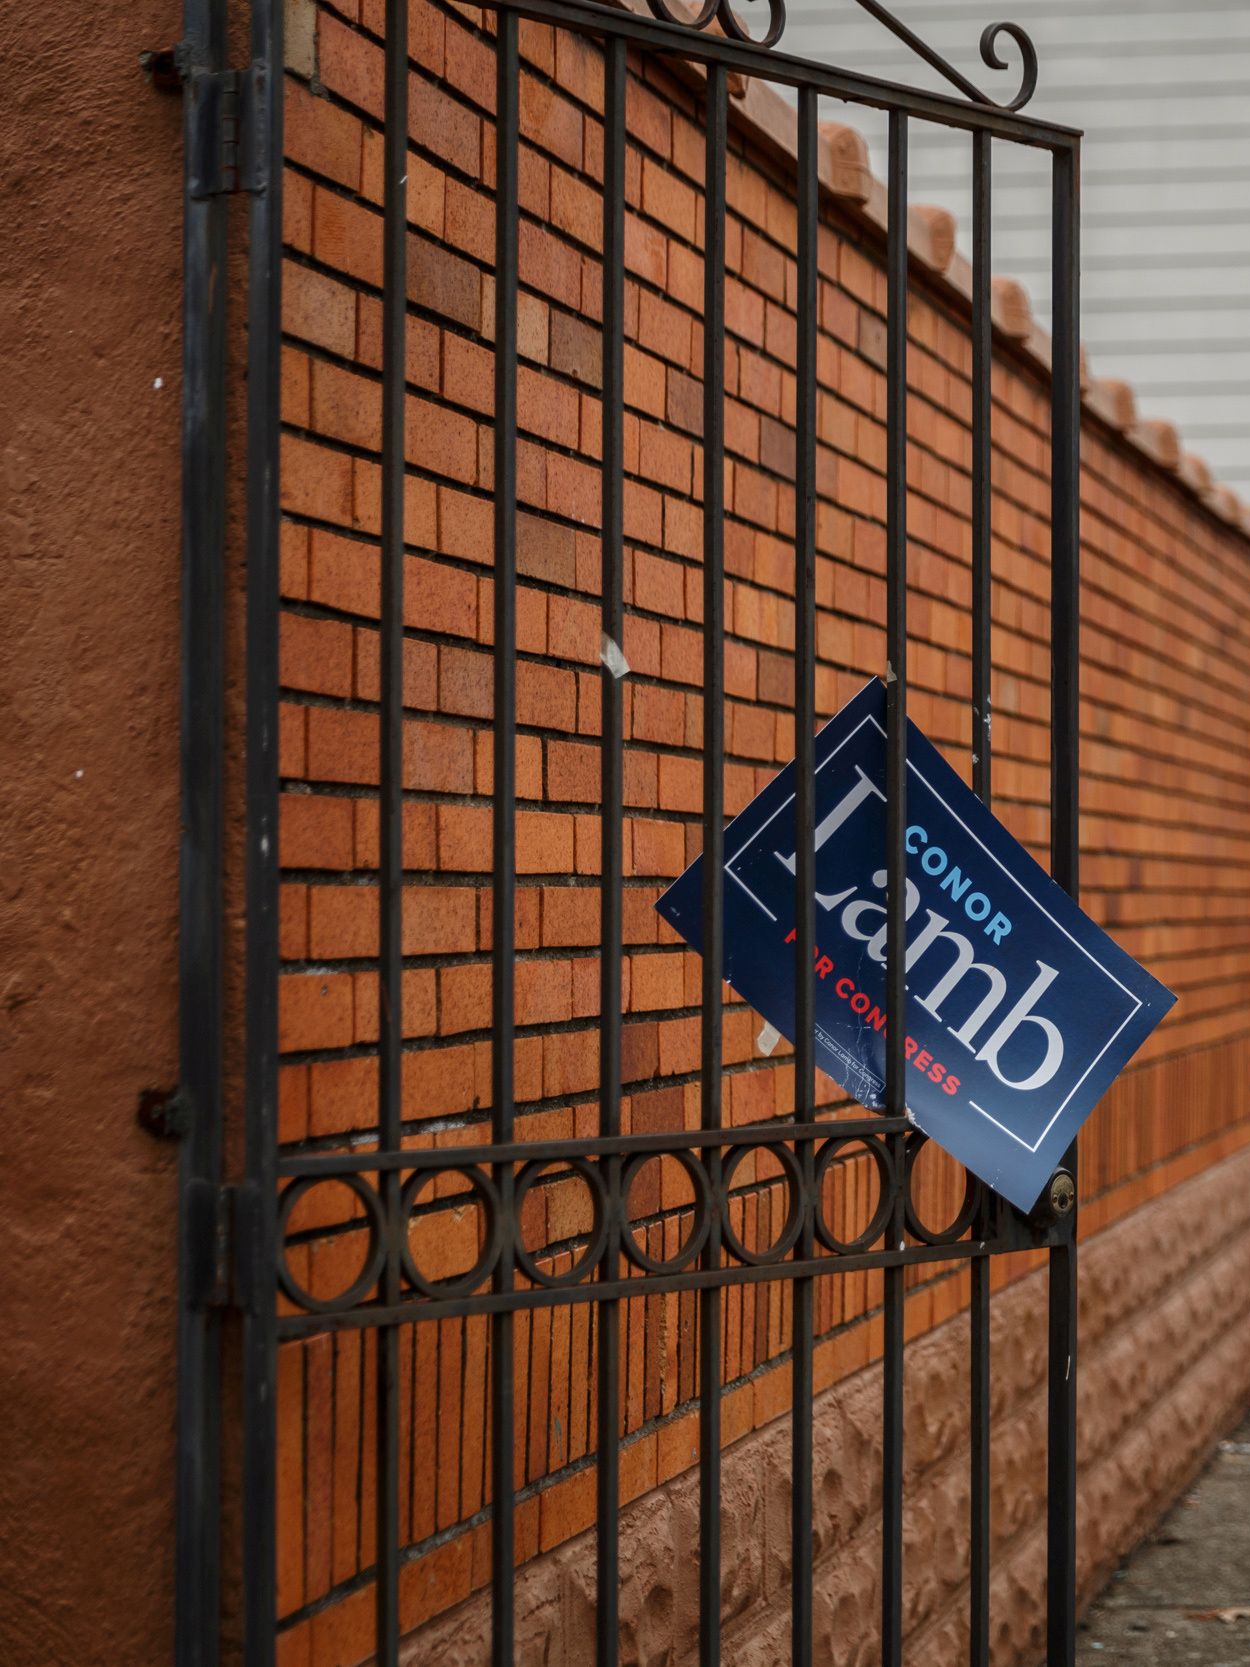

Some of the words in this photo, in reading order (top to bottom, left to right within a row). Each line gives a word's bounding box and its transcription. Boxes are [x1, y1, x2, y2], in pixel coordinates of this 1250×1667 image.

[773, 764, 1064, 1091] Lamb
[905, 825, 1012, 946] CONOR
[824, 1037, 839, 1052] Conor
[837, 1050, 852, 1064] Lamb
[851, 1062, 859, 1070] for
[858, 1068, 881, 1088] Congress
[835, 978, 961, 1095] CONRESS
